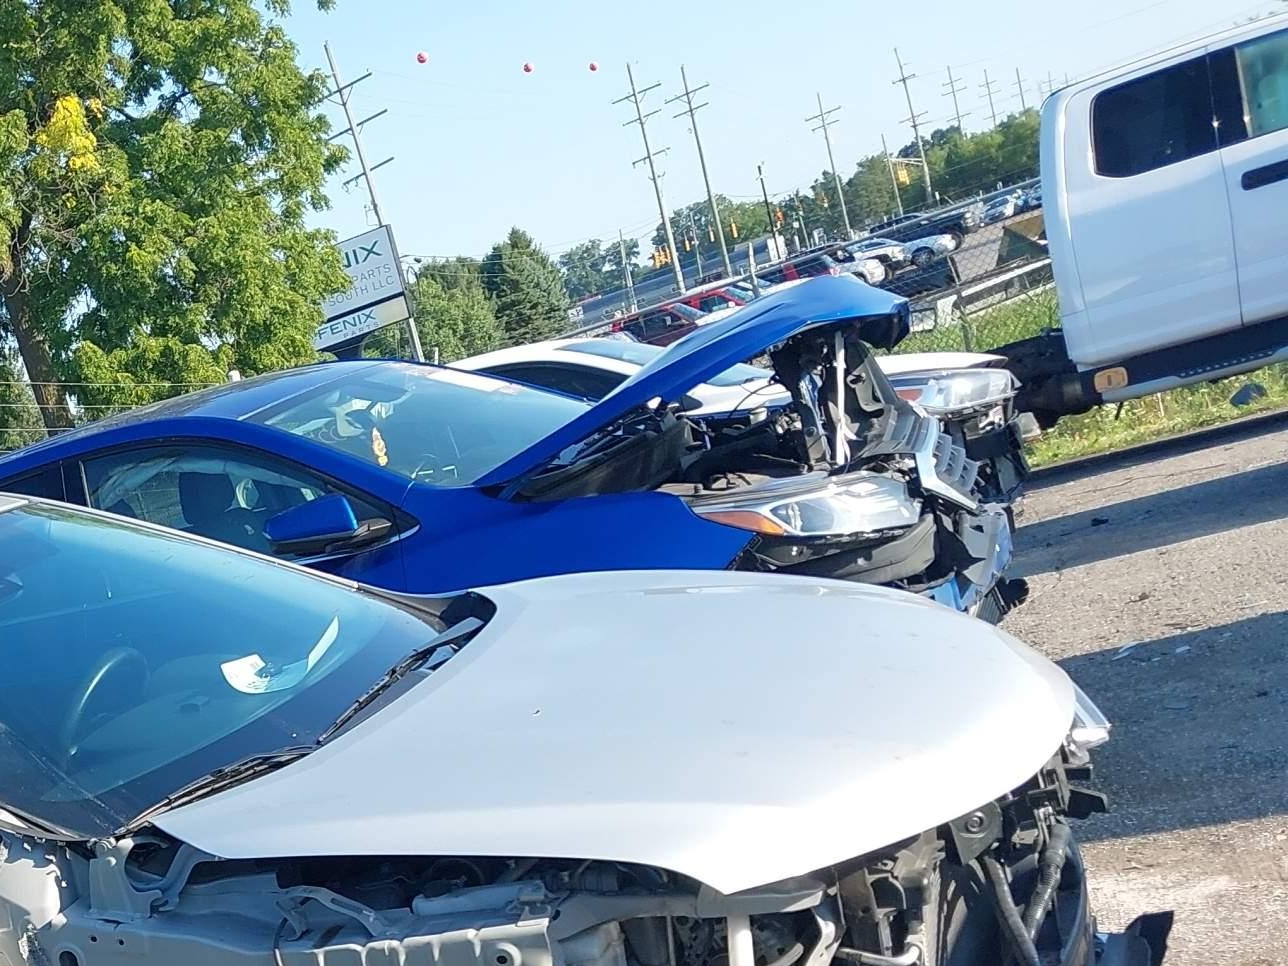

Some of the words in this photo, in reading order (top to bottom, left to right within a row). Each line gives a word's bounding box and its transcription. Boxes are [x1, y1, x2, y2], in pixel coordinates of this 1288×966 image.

[351, 264, 391, 282] PARTS
[328, 285, 369, 306] SOUTH
[372, 276, 394, 291] LLC
[317, 309, 376, 340] FENIX
